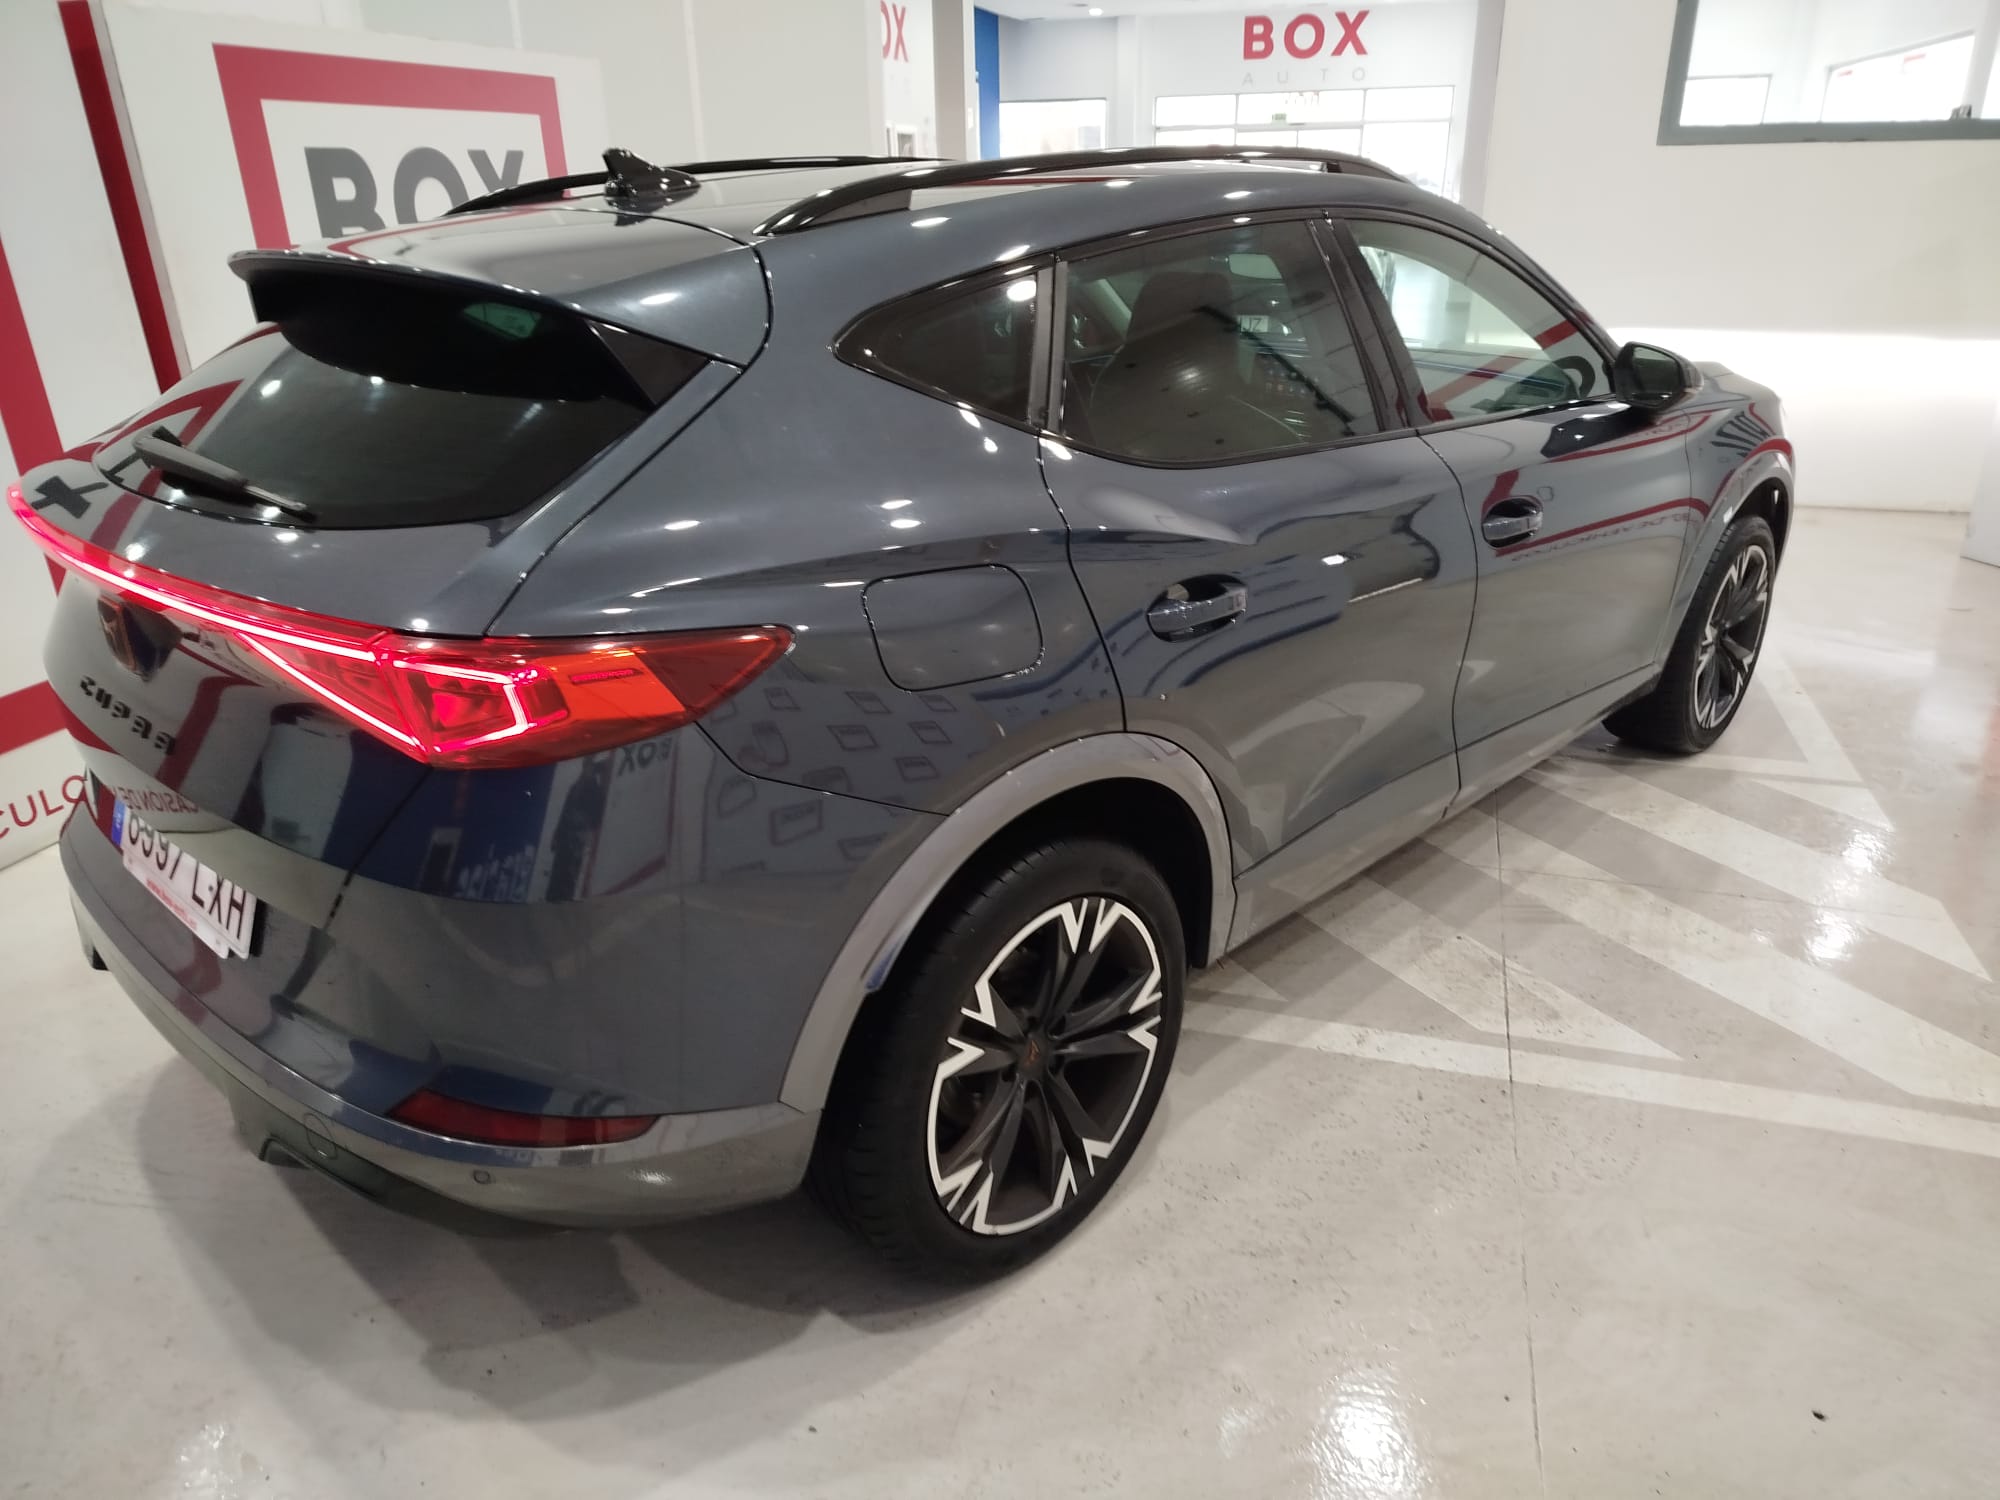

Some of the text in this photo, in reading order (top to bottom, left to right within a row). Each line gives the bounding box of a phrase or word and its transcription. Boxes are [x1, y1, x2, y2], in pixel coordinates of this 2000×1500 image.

[1243, 10, 1370, 60] BOX
[1241, 66, 1367, 87] AUTO
[191, 860, 247, 941] LXH
